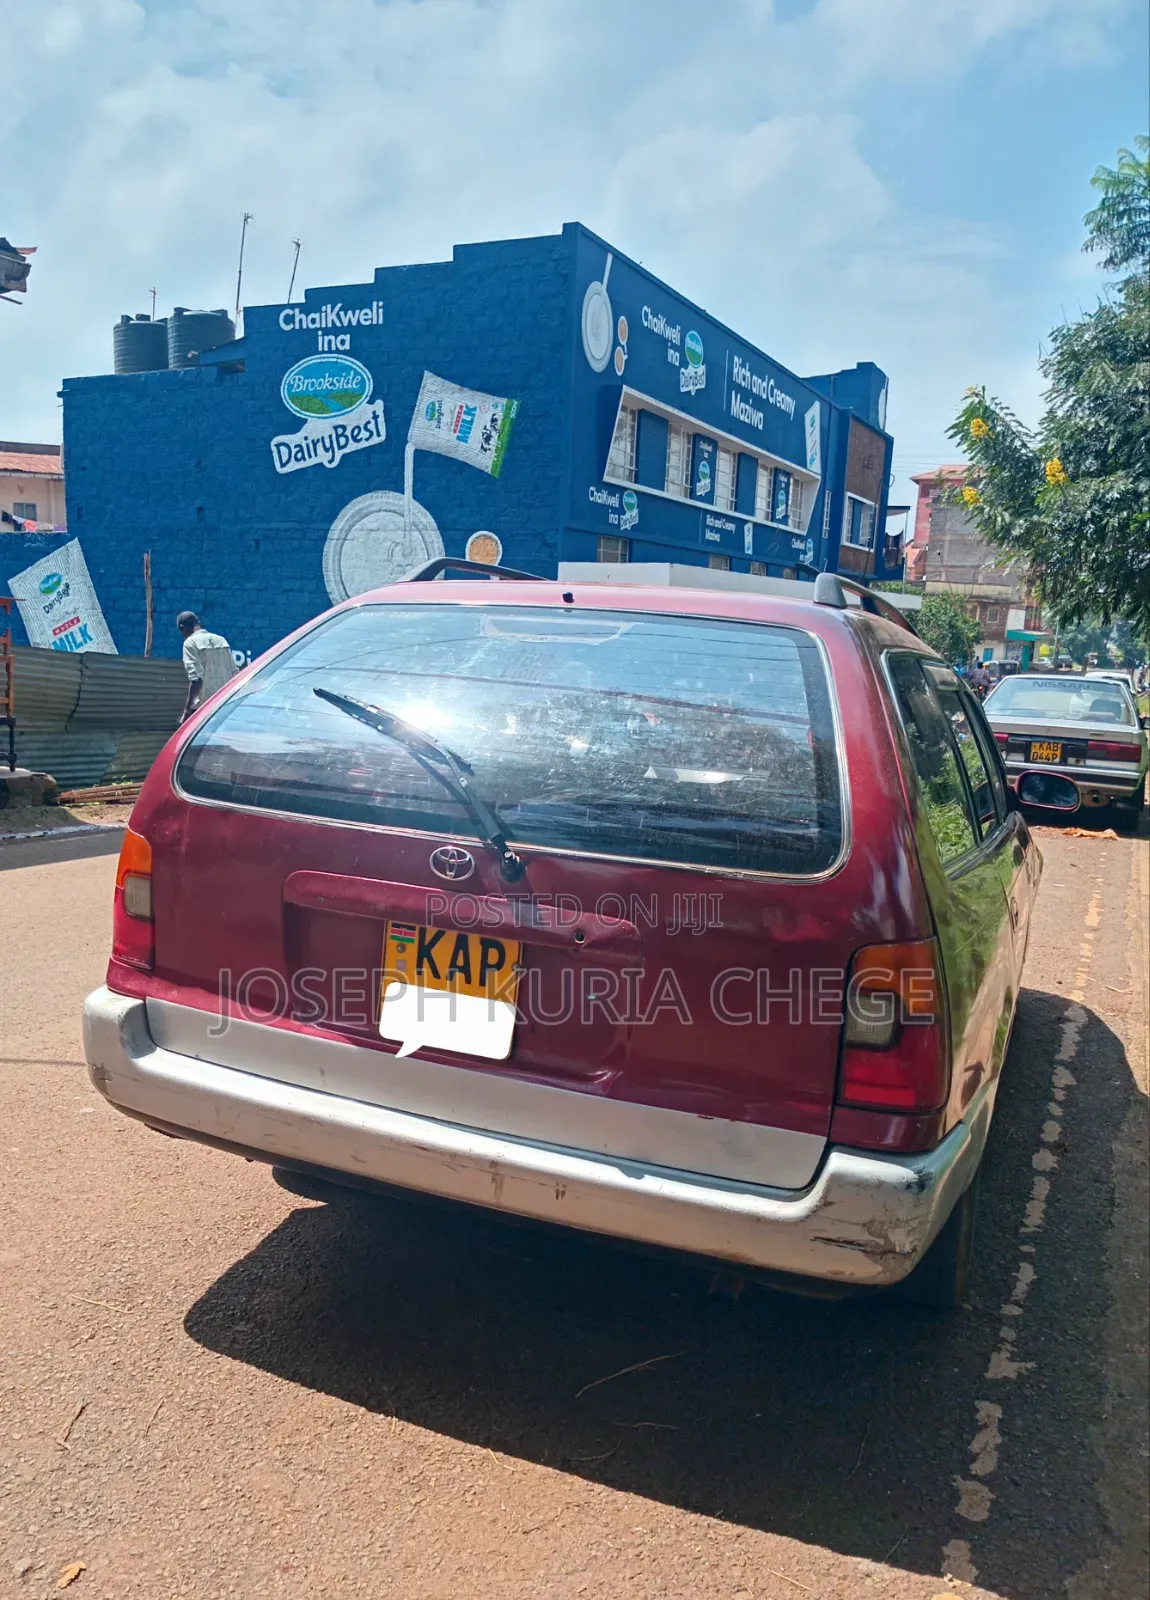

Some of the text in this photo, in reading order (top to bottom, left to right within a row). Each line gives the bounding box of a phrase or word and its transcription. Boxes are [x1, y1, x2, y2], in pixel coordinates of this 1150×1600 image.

[279, 301, 384, 331] ChaiKweli
[641, 305, 681, 346] ChaiKweli
[317, 331, 350, 351] ina
[667, 342, 680, 367] ina
[290, 371, 362, 393] Brookside
[733, 356, 796, 421] Rich and Creamy
[456, 404, 478, 445] MILK
[730, 390, 764, 430] Maziwa
[274, 410, 382, 468] DairyBest
[608, 509, 619, 525] ina
[52, 623, 93, 652] MILK
[1032, 680, 1091, 690] NISSAN
[1038, 742, 1059, 752] KAB
[416, 926, 506, 987] KAP
